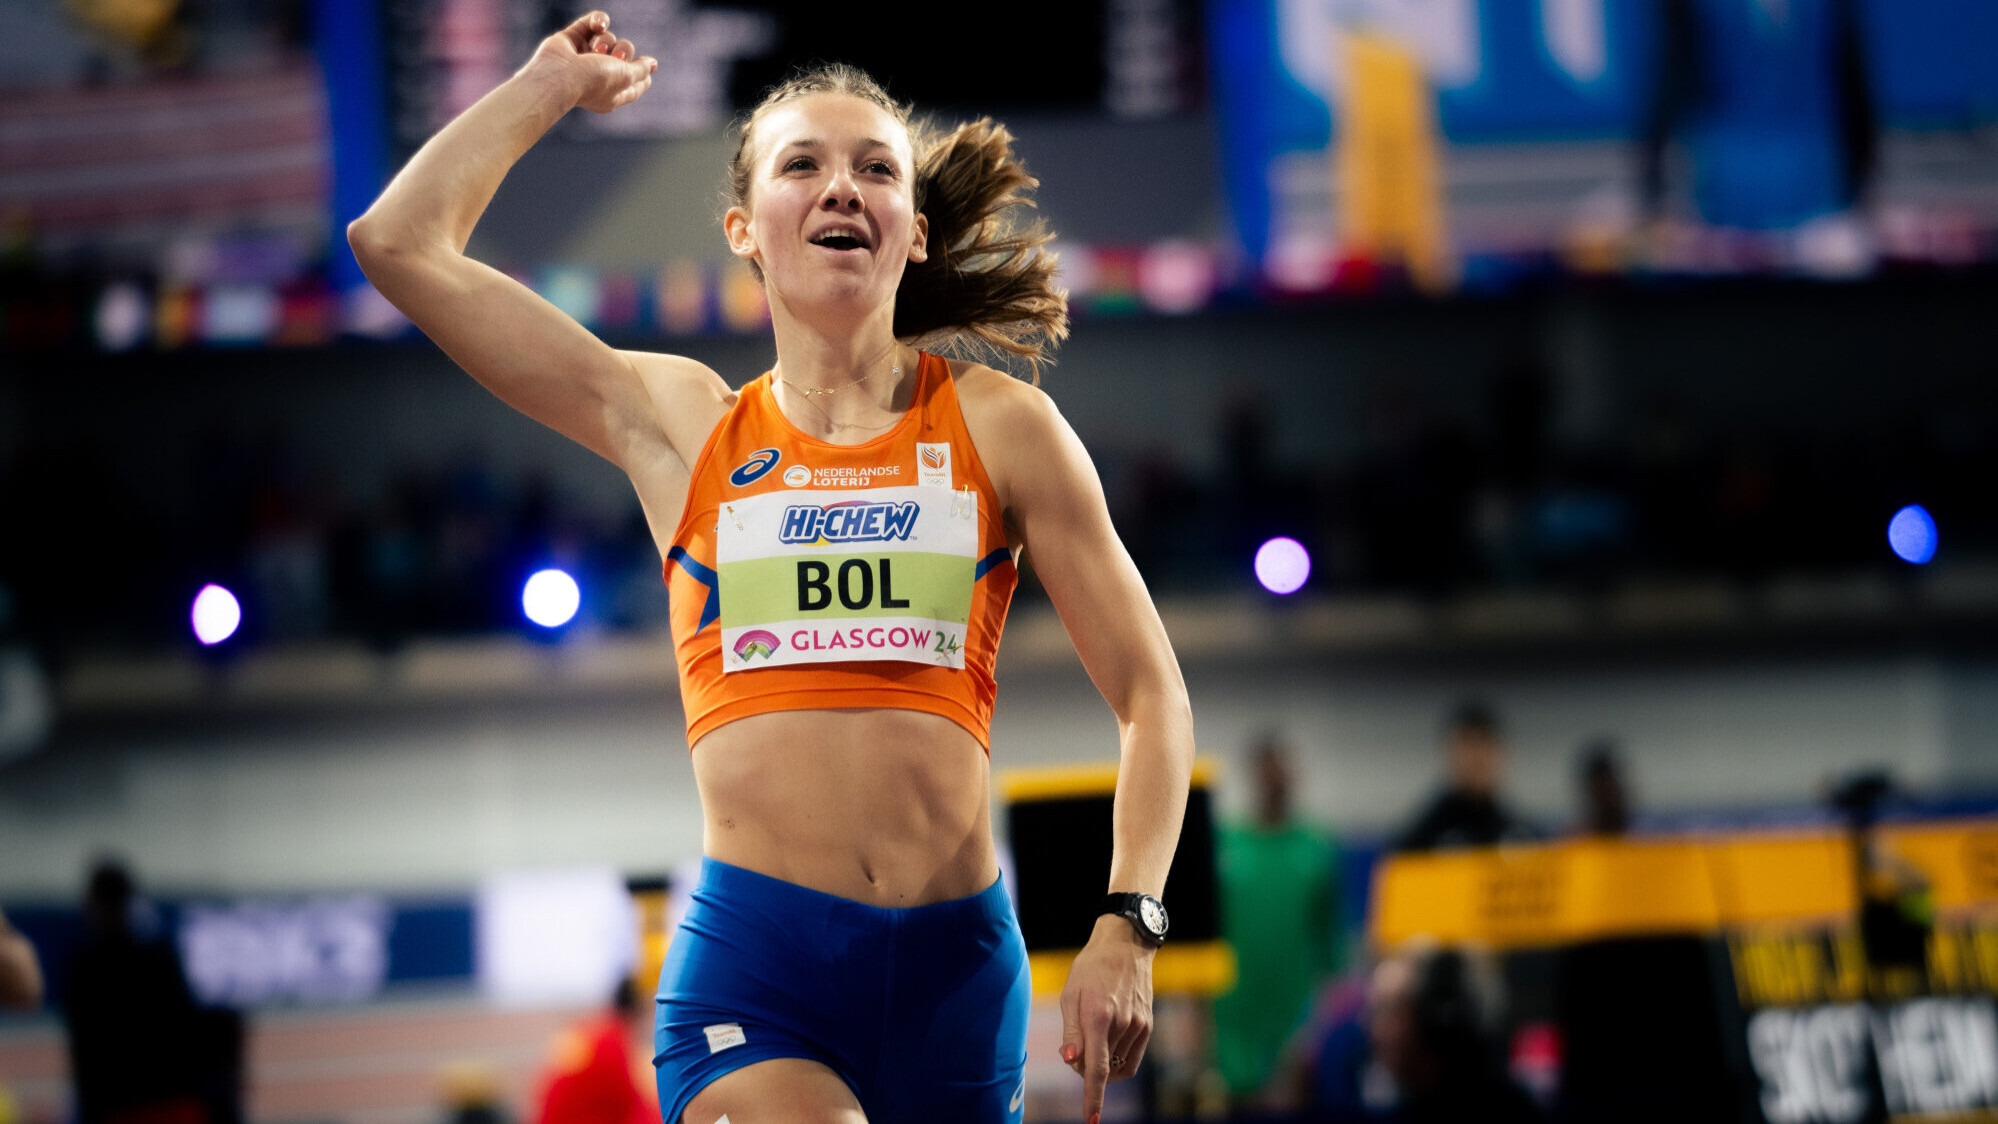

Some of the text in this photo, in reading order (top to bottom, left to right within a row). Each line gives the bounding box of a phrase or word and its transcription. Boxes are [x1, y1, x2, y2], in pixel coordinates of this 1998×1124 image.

[813, 477, 870, 486] LOTERIJ
[814, 465, 900, 478] NEDERLANDSE
[779, 501, 920, 545] HI-CHEW
[797, 558, 910, 611] BOL
[790, 627, 957, 655] GLASGOW 24
